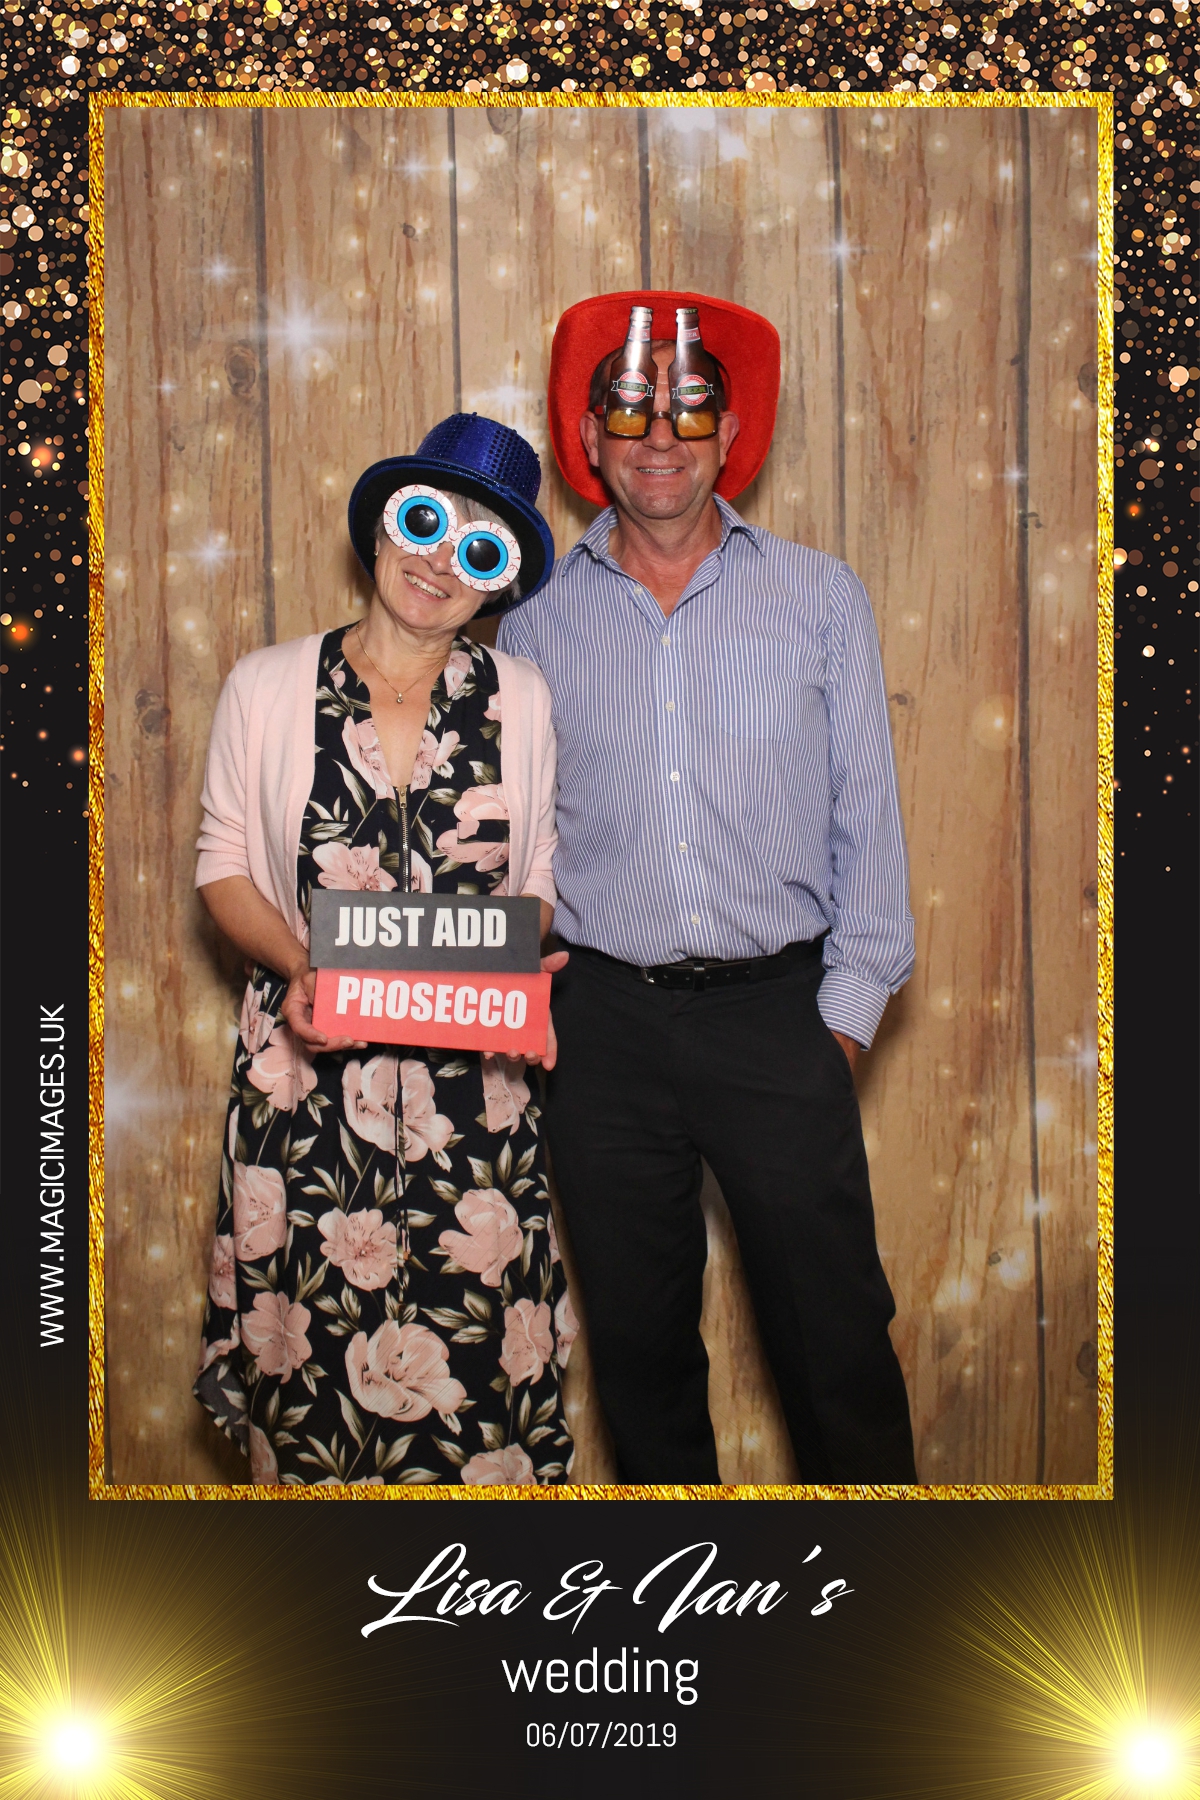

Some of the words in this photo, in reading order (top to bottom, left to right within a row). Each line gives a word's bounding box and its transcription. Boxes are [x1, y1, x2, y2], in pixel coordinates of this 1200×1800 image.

[619, 382, 646, 392] BEER
[680, 386, 706, 395] BEER
[335, 906, 424, 947] JUST
[432, 908, 507, 947] ADD
[336, 976, 527, 1029] PROSECCO
